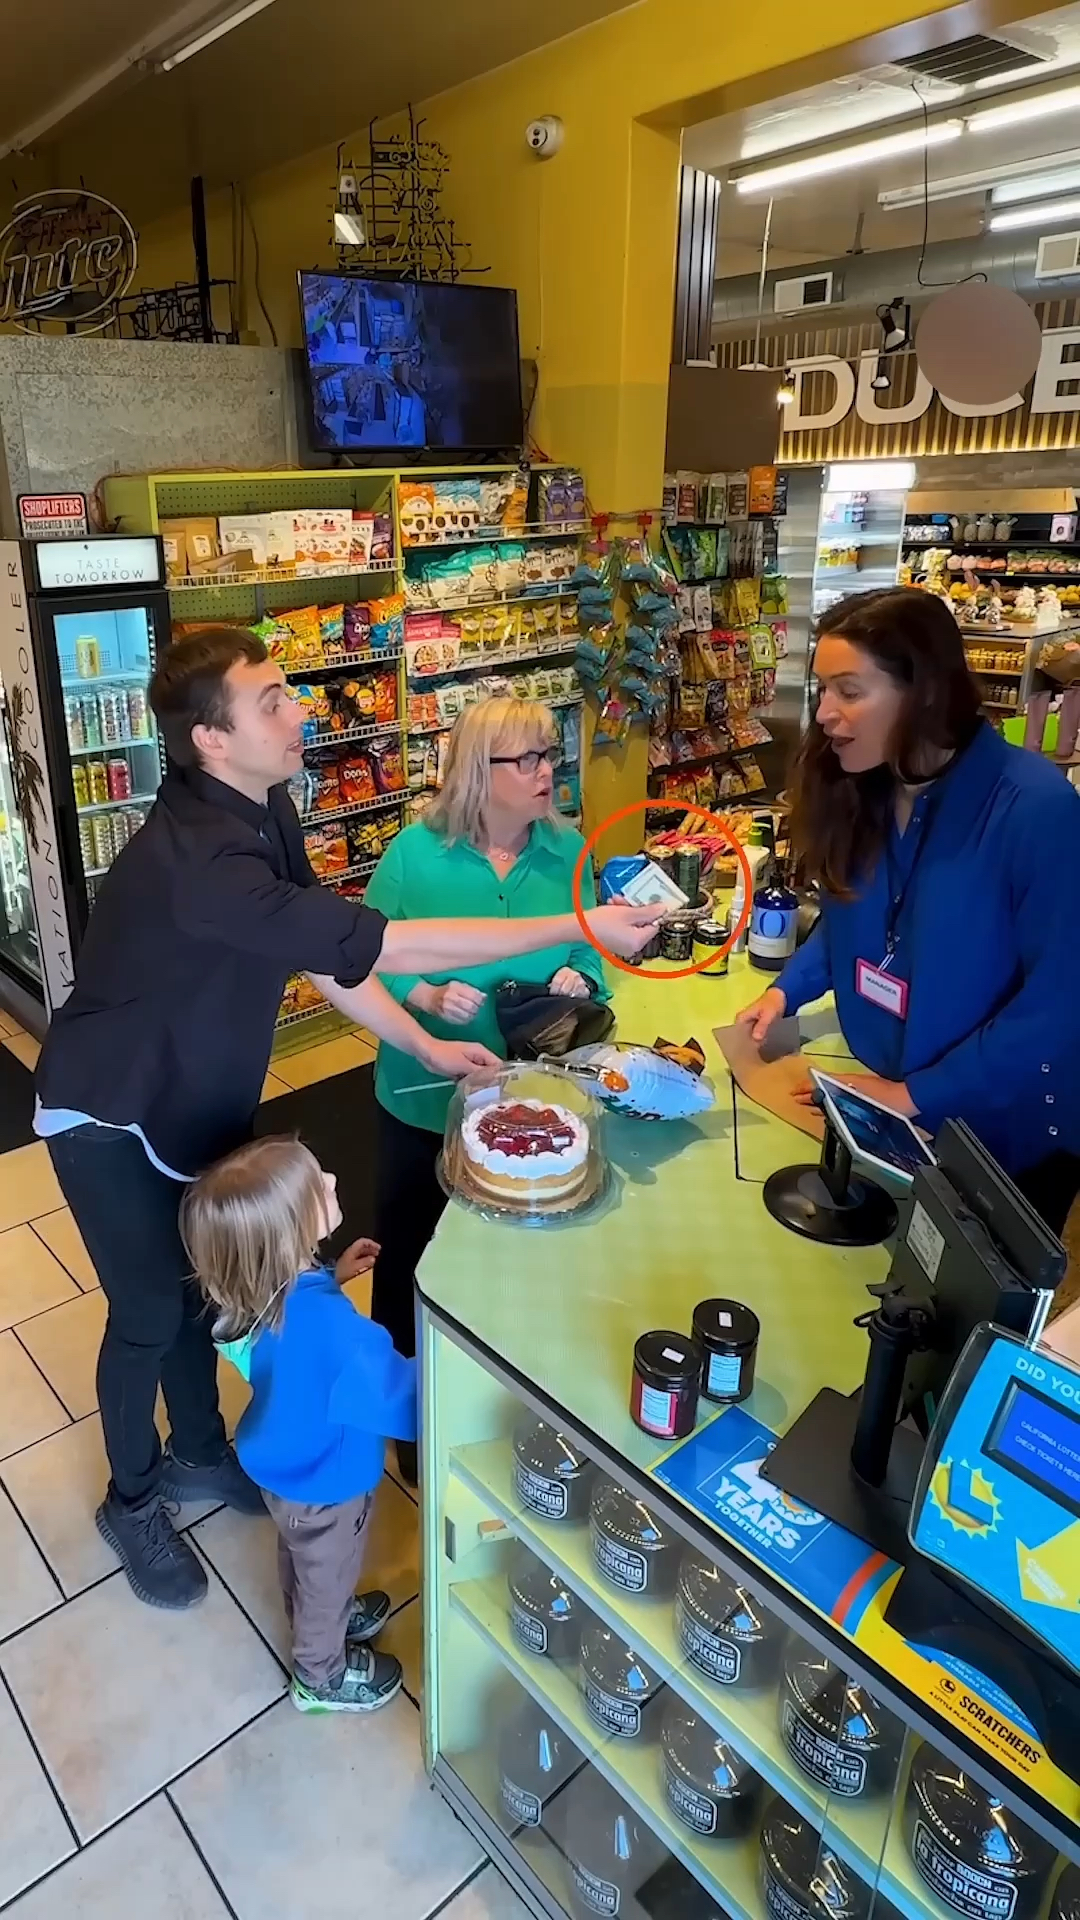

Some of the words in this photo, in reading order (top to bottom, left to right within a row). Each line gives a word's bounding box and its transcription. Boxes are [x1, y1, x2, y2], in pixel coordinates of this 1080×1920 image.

[24, 499, 81, 516] SHOPLIFTERS
[64, 519, 72, 529] TO
[74, 518, 84, 528] THE
[55, 569, 144, 584] TOMORROW
[77, 557, 120, 570] TASTE
[8, 562, 38, 748] COOLER
[865, 976, 898, 996] MANAGER
[1015, 1356, 1047, 1382] DID
[1020, 1420, 1057, 1448] CALIFORNIA
[1014, 1435, 1036, 1453] CHECK
[1036, 1448, 1064, 1471] TICKETS
[714, 1500, 774, 1549] TOGETHER
[715, 1476, 802, 1550] YEARS
[934, 1693, 952, 1711] LITTLE
[953, 1709, 968, 1723] PLAY
[968, 1721, 981, 1735] CAN
[982, 1732, 999, 1749] MAKE
[1000, 1746, 1017, 1763] YOUR
[1018, 1761, 1031, 1773] DAY
[959, 1695, 1041, 1765] SCRATCHERS
[956, 1863, 992, 1890] BOOCH
